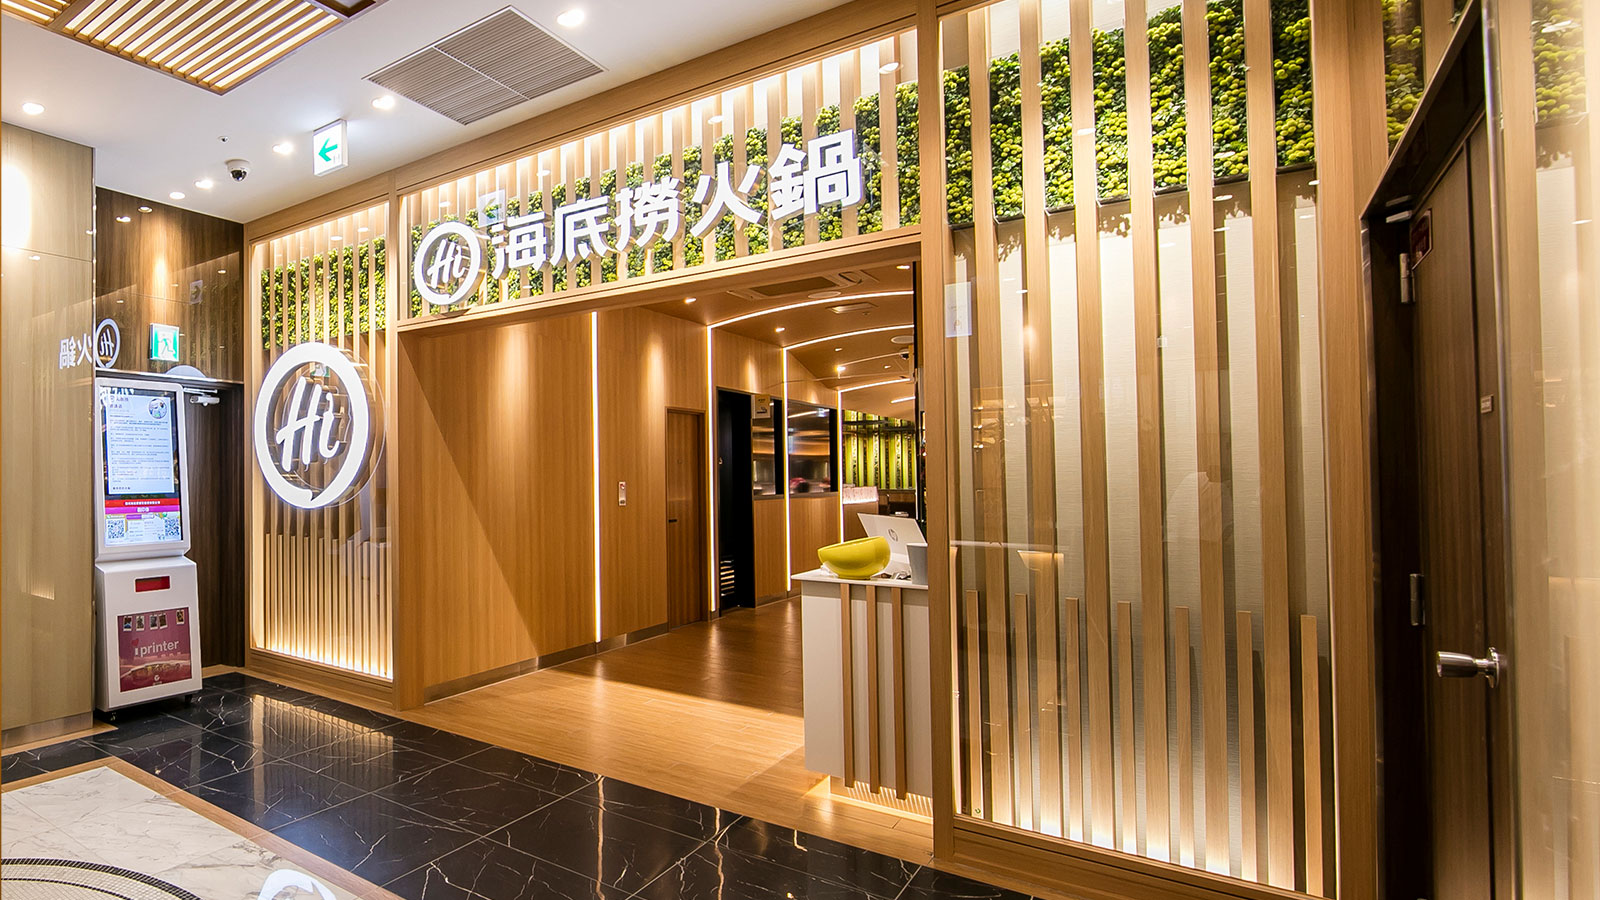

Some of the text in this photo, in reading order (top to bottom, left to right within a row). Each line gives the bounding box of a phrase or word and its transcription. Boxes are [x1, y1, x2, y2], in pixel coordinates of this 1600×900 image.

[491, 128, 863, 280] 海底撈火鍋
[427, 239, 466, 289] Hi
[276, 376, 340, 472] Hi
